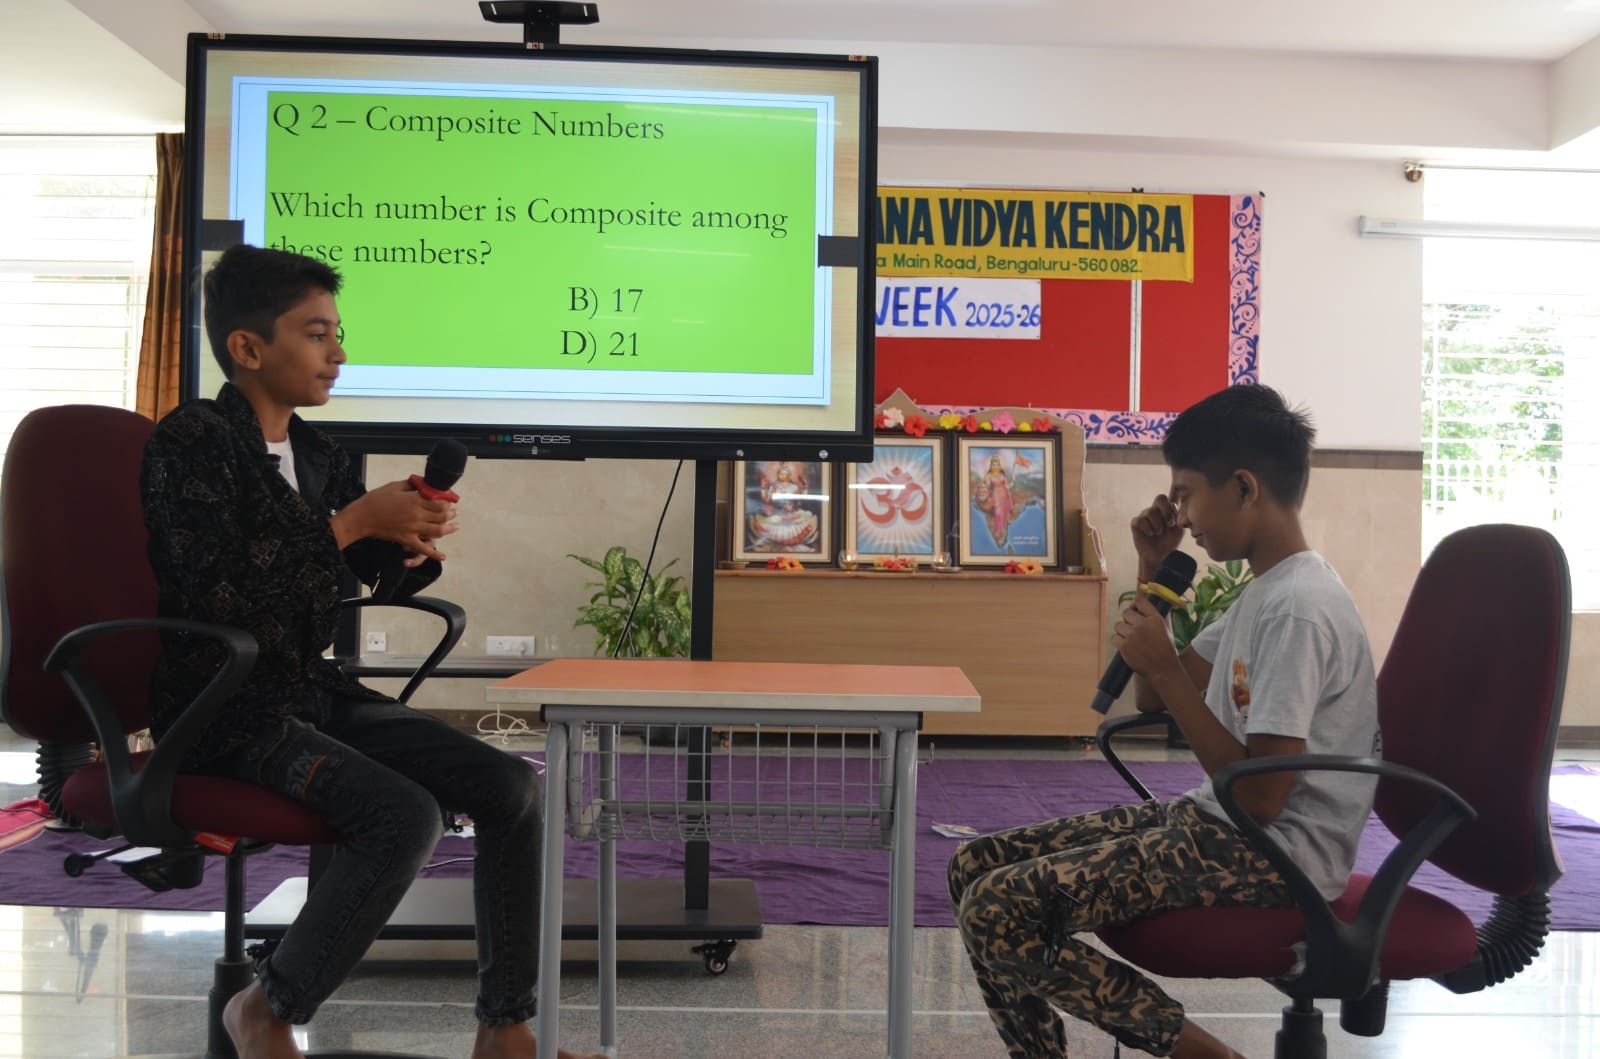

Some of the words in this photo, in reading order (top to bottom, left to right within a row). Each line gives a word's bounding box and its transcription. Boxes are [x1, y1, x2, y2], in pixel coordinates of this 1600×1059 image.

[273, 103, 301, 137] Q
[311, 104, 327, 129] 2
[366, 105, 521, 142] Composite
[533, 111, 665, 139] Numbers
[270, 191, 364, 219] Which
[375, 195, 487, 222] number
[496, 197, 516, 222] is
[527, 198, 682, 233] Composite
[692, 209, 789, 239] among
[939, 198, 1037, 248] VIDYA
[1045, 201, 1185, 253] KENDRA
[353, 238, 492, 266] numbers?
[893, 253, 930, 269] Main
[934, 254, 982, 273] Road,
[568, 286, 598, 320] B)
[612, 288, 644, 313] 17
[560, 330, 597, 364] D)
[609, 331, 639, 357] 21
[512, 434, 571, 444] senses
